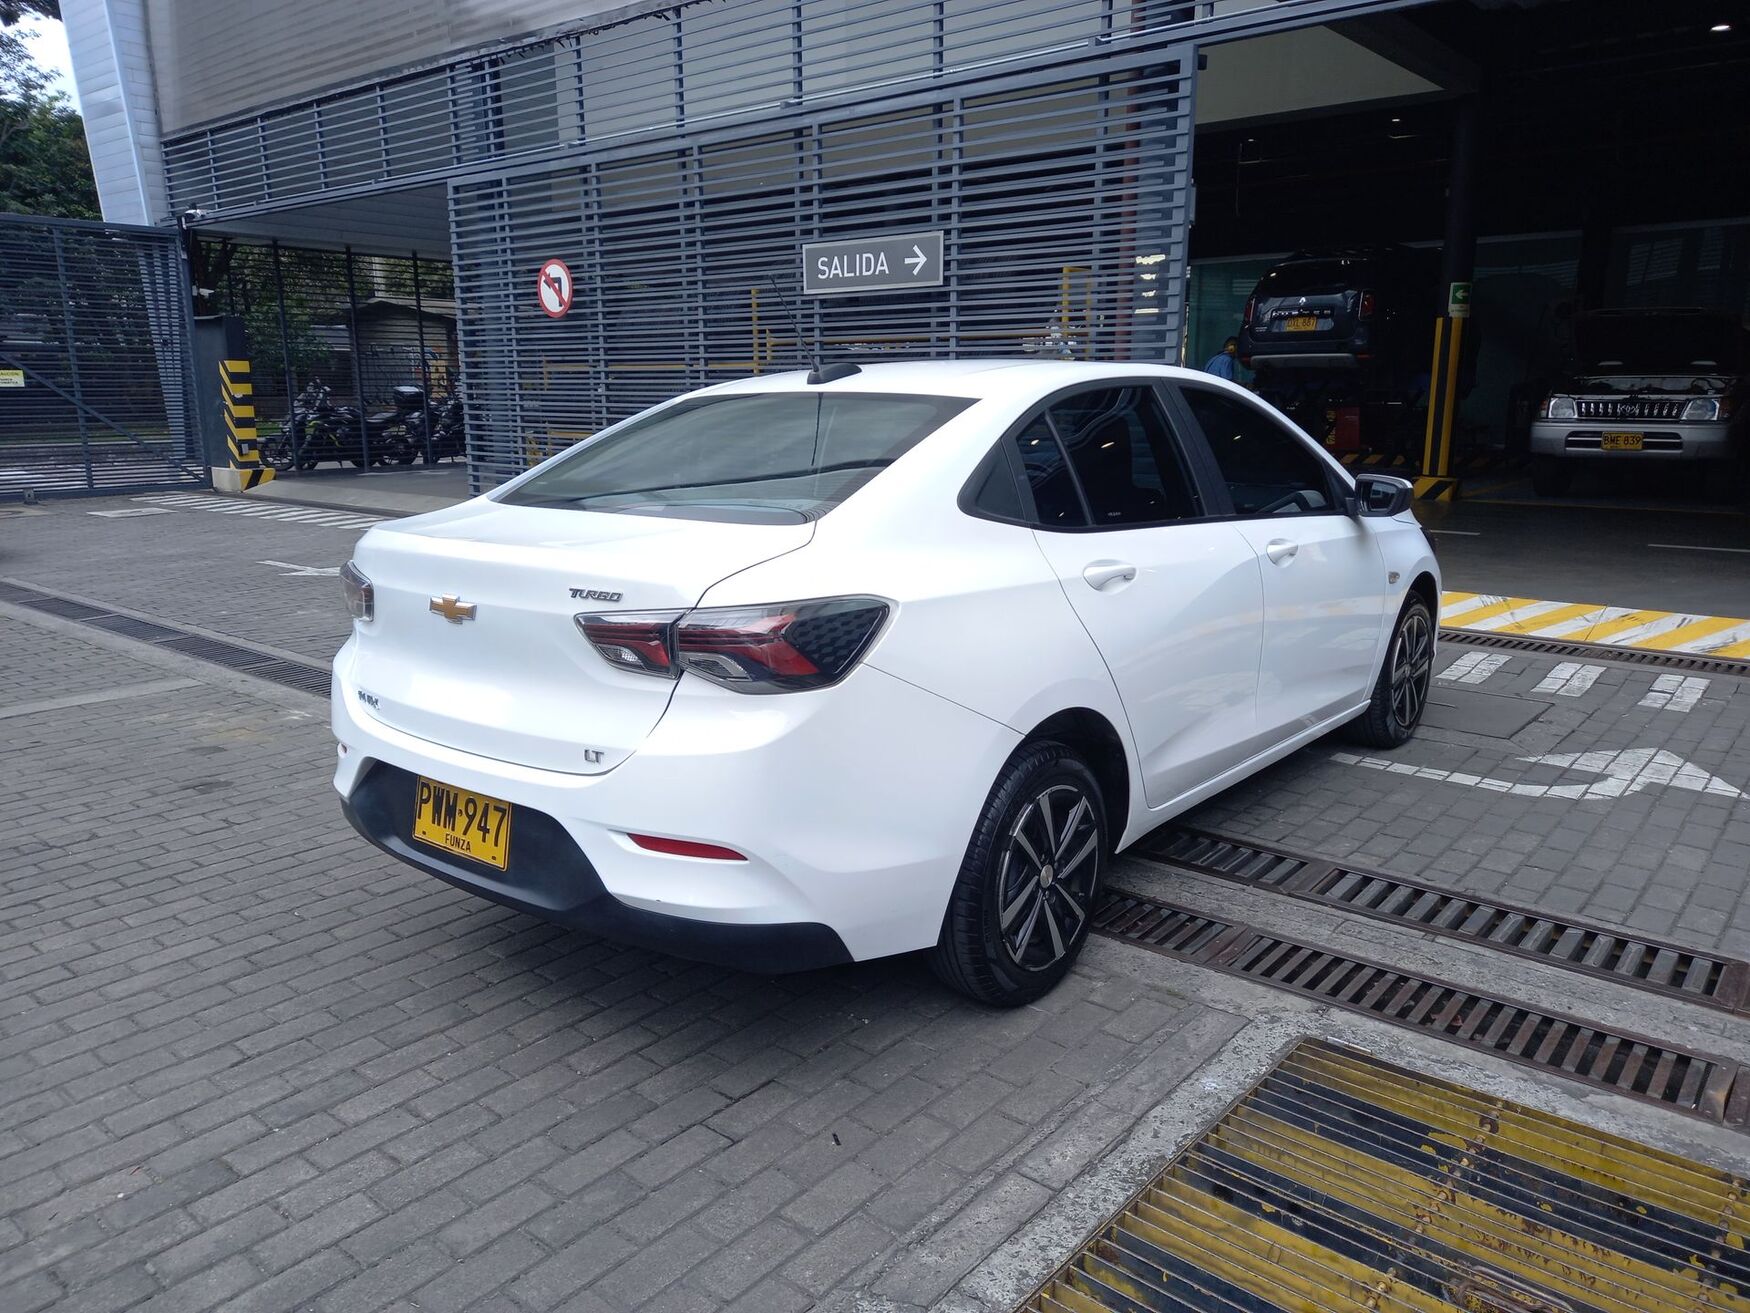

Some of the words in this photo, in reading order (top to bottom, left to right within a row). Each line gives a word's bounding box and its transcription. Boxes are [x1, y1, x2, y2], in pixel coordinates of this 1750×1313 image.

[817, 251, 890, 279] SALIDA
[1603, 435, 1621, 446] BME
[1622, 435, 1642, 446] 839
[568, 588, 624, 602] TURBO
[584, 749, 605, 764] LT
[417, 781, 459, 832] PWM
[462, 797, 508, 848] 947
[444, 833, 472, 853] FUNZA
